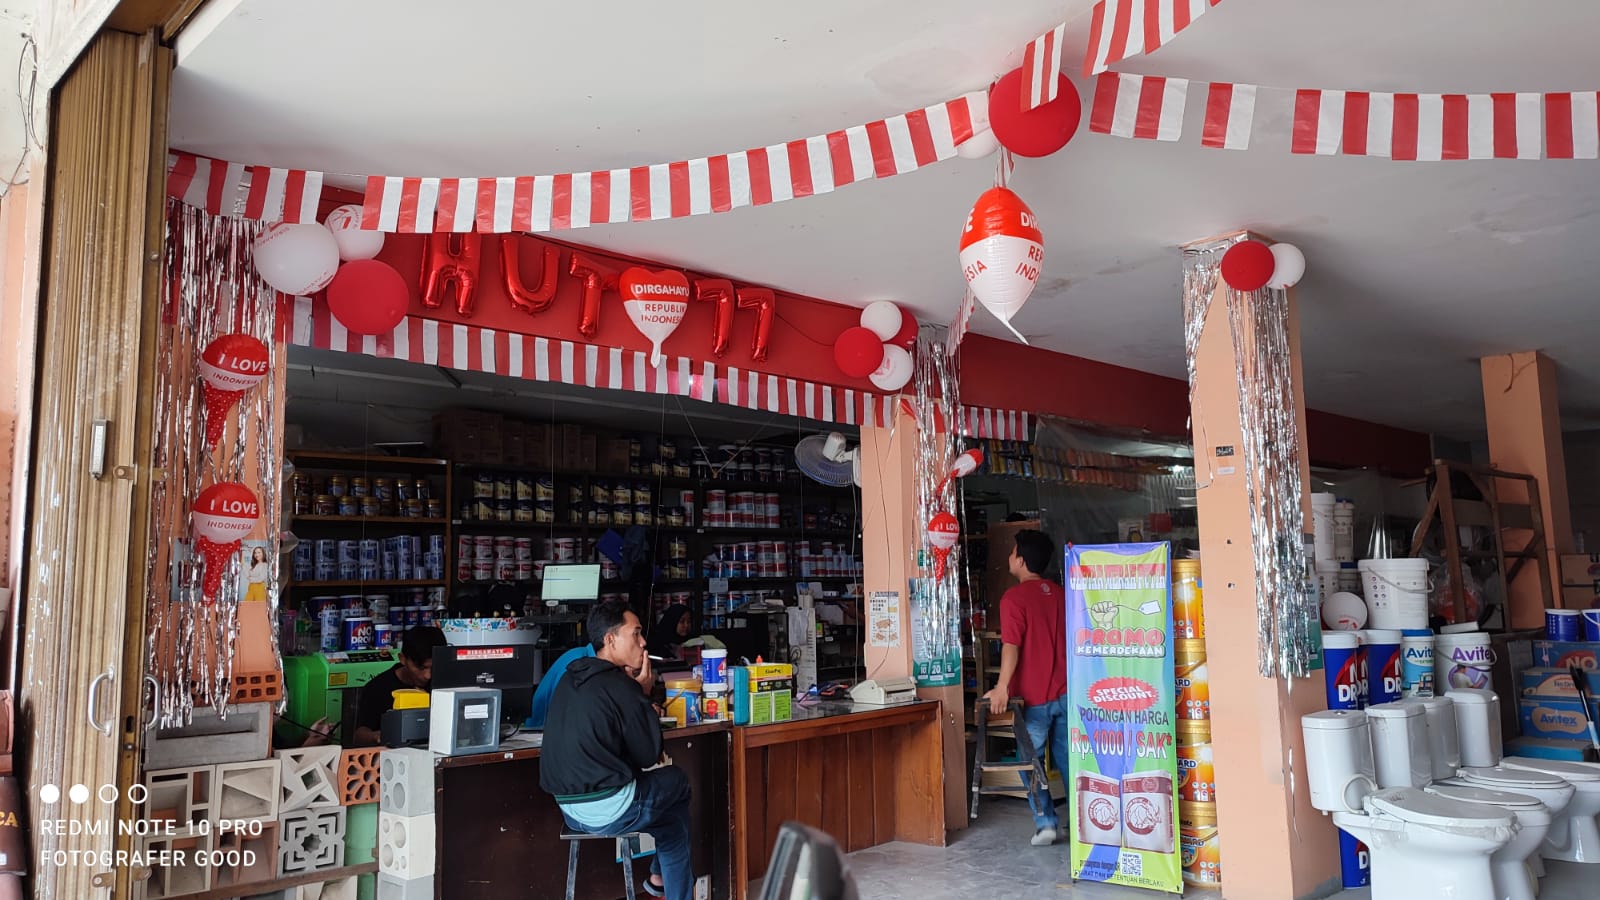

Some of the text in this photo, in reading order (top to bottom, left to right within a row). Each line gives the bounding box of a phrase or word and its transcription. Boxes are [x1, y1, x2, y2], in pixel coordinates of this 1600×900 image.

[231, 356, 267, 372] LOVE
[210, 499, 257, 514] I LOVE
[207, 521, 252, 530] INDONESIA
[1077, 628, 1164, 646] PROMO
[1077, 645, 1163, 656] KEMERDEKAAN
[1407, 646, 1433, 659] Avit
[1452, 646, 1491, 662] Avite
[1566, 655, 1599, 671] NO
[1096, 685, 1143, 696] SPECIAL
[1383, 676, 1402, 694] DR
[1338, 684, 1358, 703] DR
[1080, 707, 1169, 726] POTONGAN HARGA
[1541, 712, 1578, 727] Avitex
